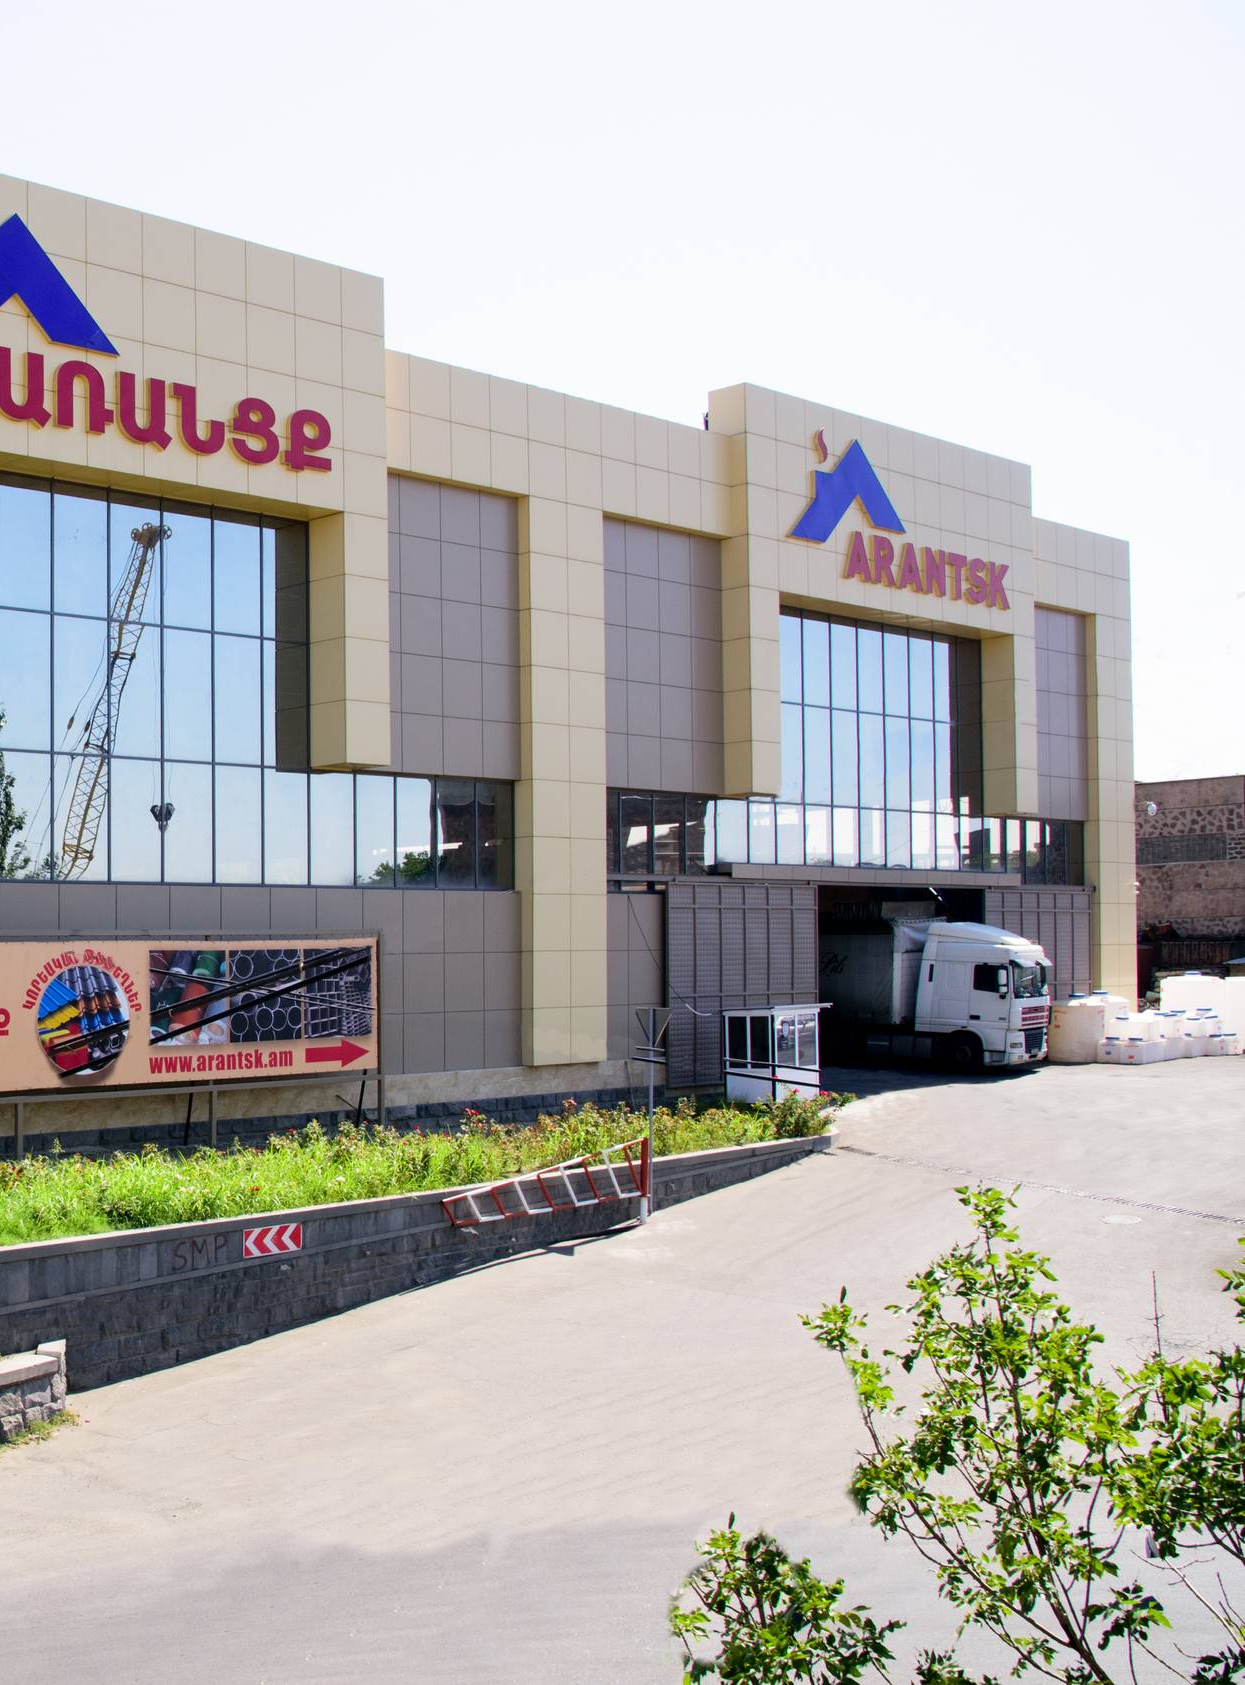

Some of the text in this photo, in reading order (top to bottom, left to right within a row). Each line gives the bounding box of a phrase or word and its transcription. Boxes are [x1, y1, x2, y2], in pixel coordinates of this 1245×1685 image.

[843, 530, 1010, 610] ARANTSK
[149, 1048, 294, 1074] www.arantsk.am
[171, 1234, 228, 1272] SMP
